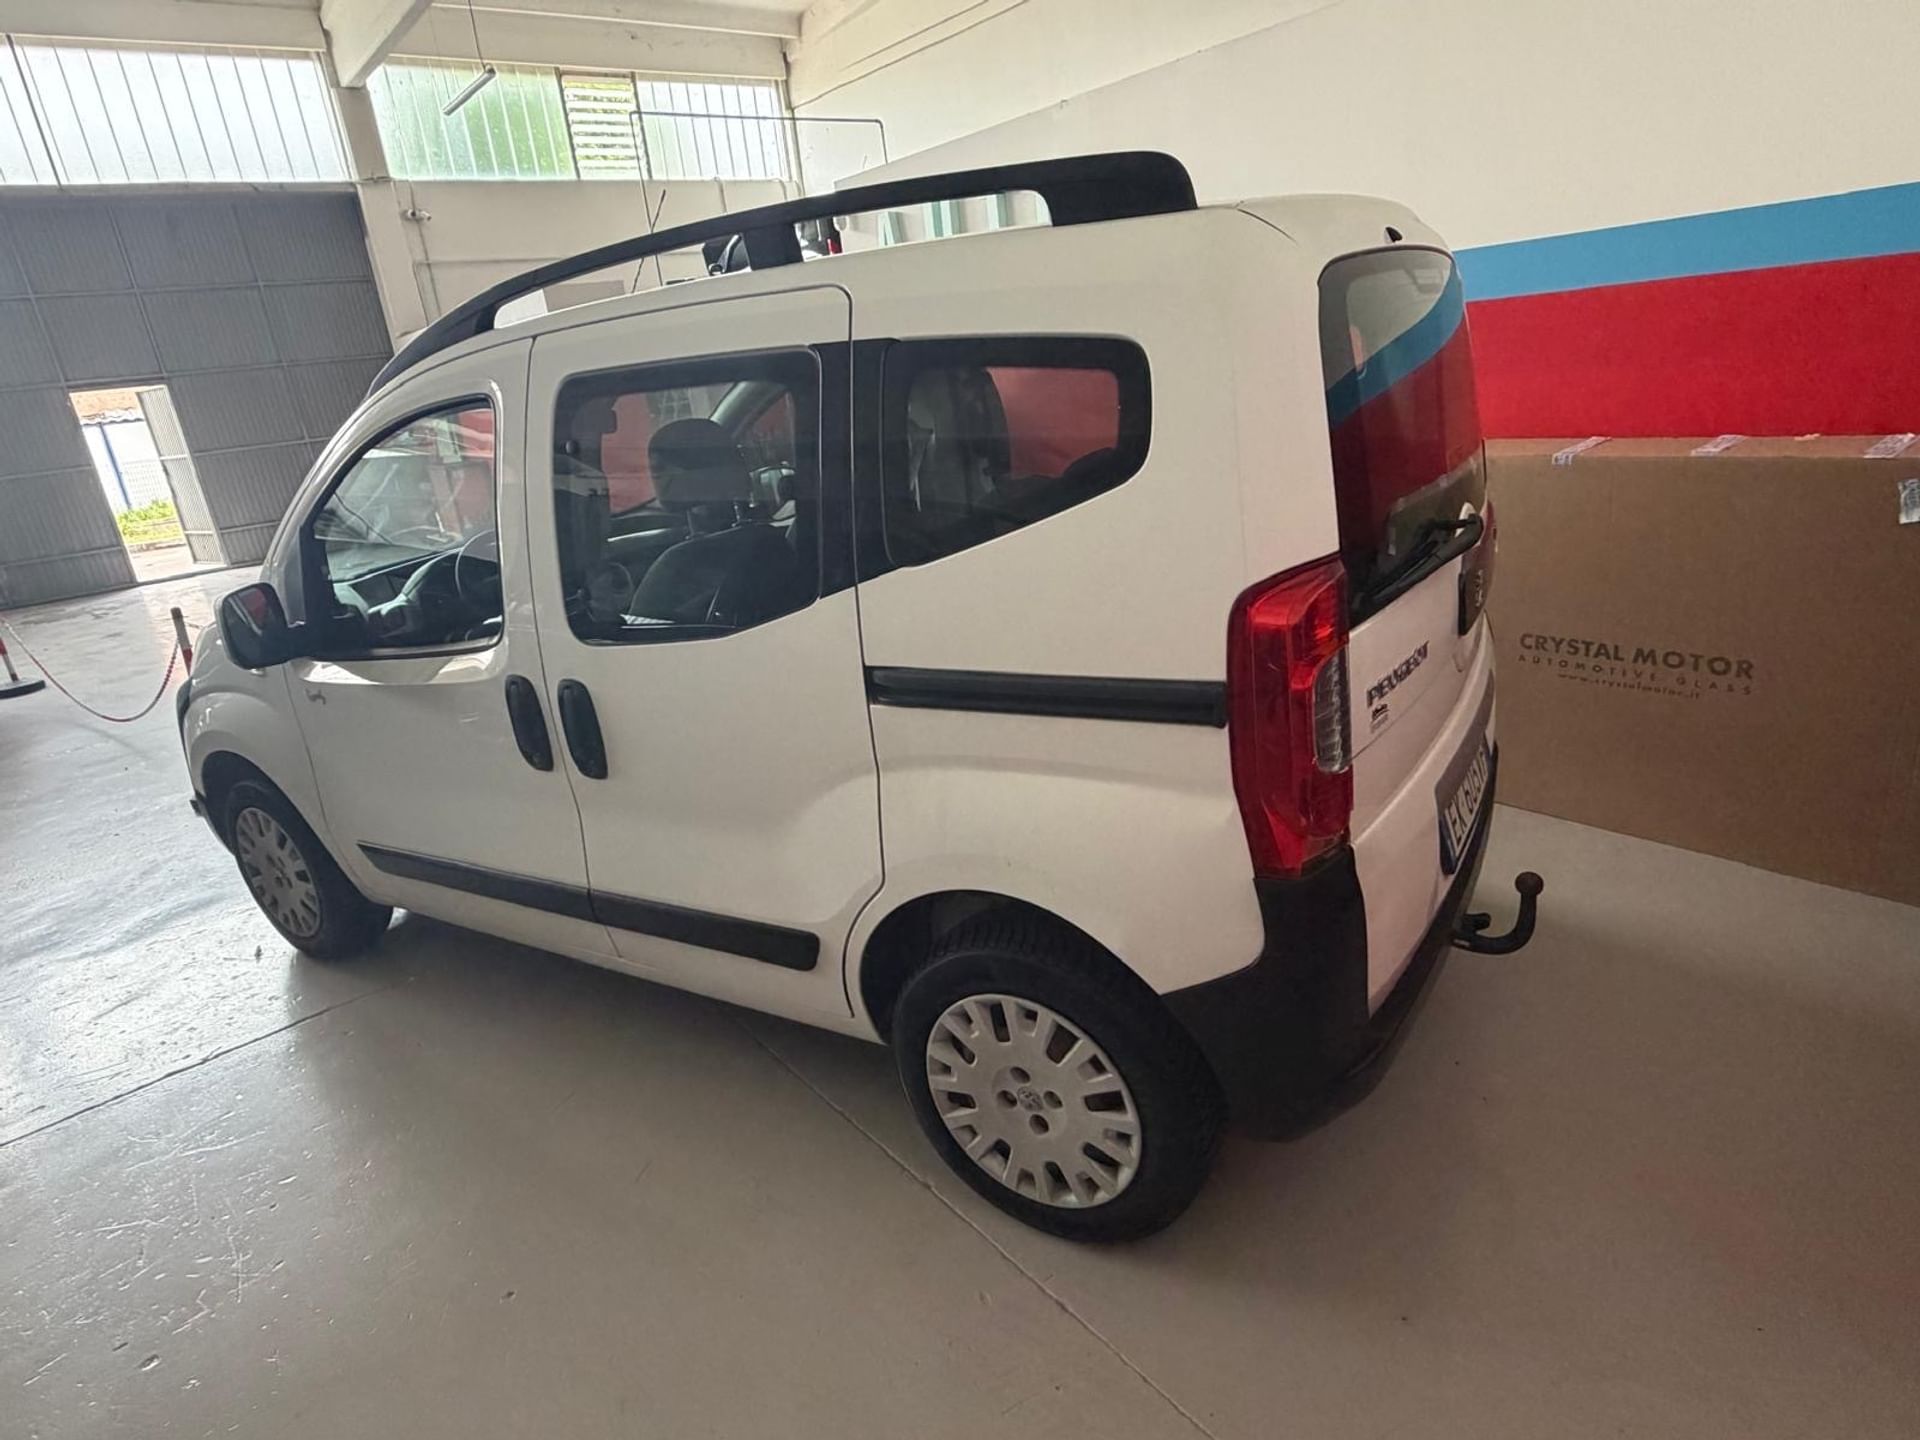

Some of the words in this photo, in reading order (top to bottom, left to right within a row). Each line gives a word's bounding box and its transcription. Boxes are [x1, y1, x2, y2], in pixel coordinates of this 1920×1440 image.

[1517, 653, 1658, 683] AUTOMOTIVE
[1675, 676, 1752, 696] GLASS
[1519, 632, 1625, 662] CRYSTAL
[1631, 647, 1755, 681] MOTOR
